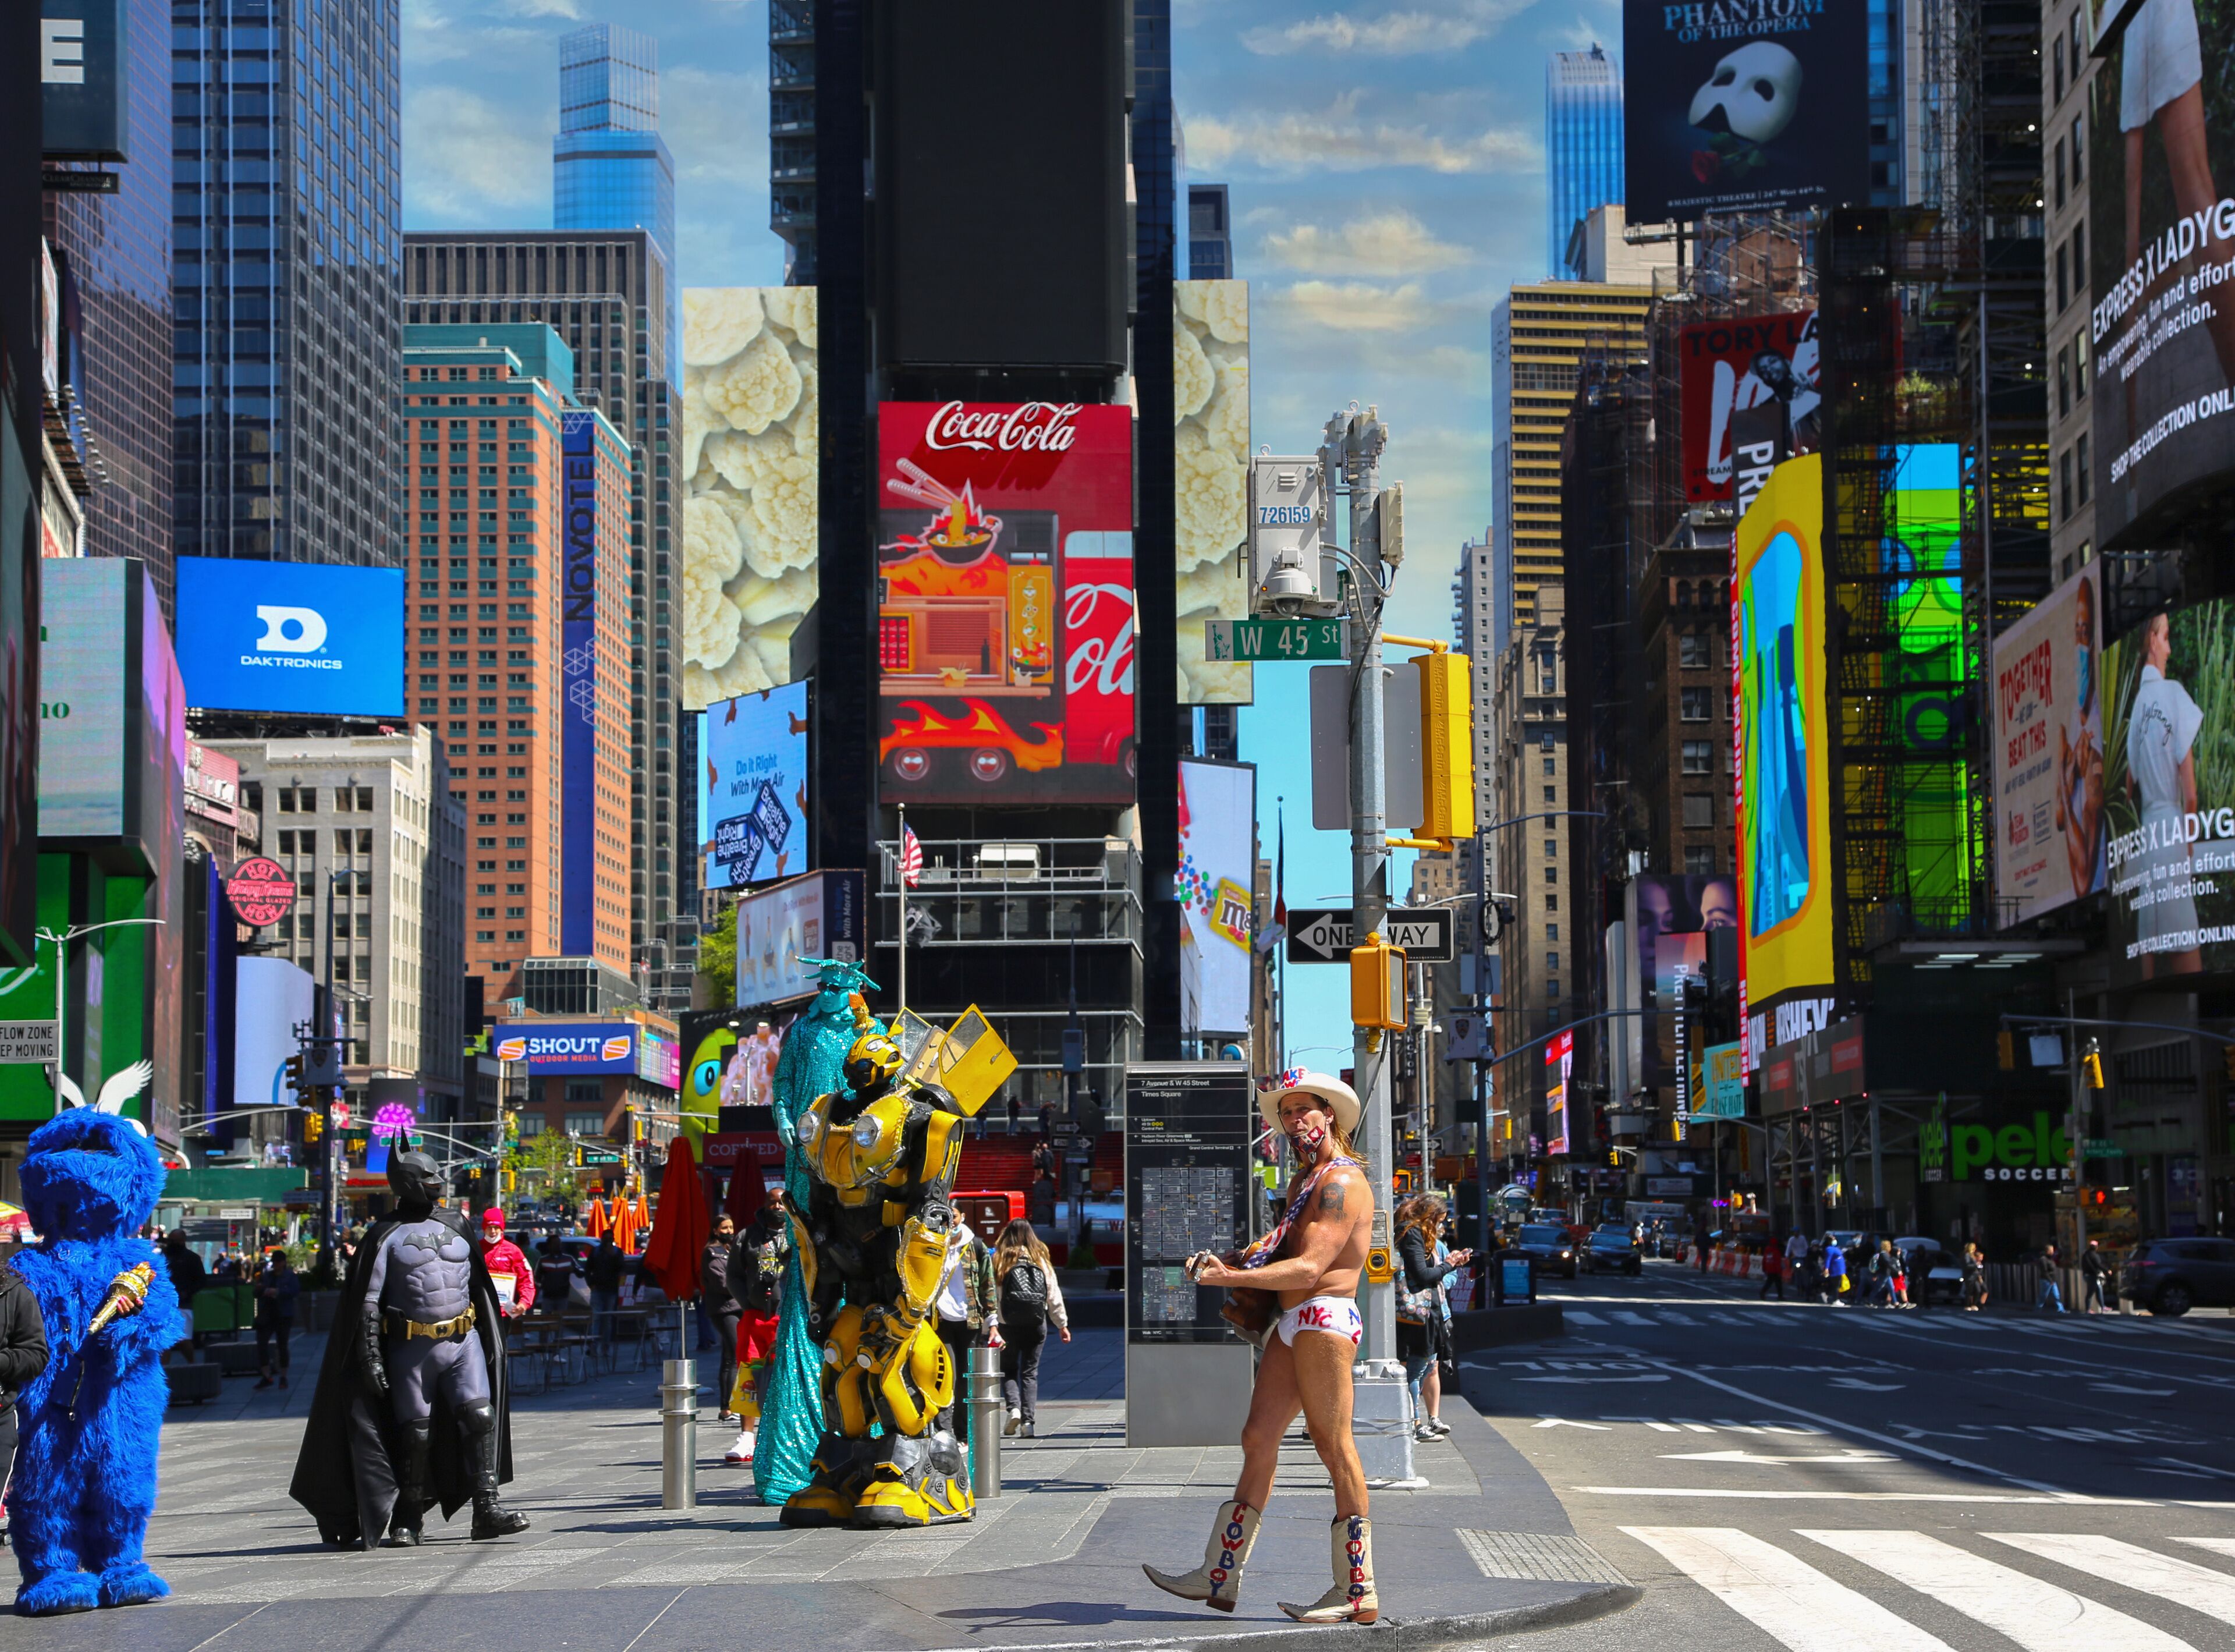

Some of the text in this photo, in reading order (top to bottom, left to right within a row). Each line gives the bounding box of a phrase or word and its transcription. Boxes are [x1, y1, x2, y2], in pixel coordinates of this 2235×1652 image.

[1663, 0, 1825, 30] PHANTOM
[1678, 16, 1811, 44] OF THE OPERA
[1674, 196, 1715, 206] MAJESTIC
[1717, 192, 1757, 203] THEATRE
[2093, 258, 2144, 344] EXPRESS
[2146, 243, 2155, 288] X
[2107, 313, 2149, 367] empowering,
[2149, 298, 2162, 324] fun
[2163, 275, 2185, 311] and
[1686, 323, 1777, 357] TORY
[2120, 300, 2217, 383] wearable collection.
[925, 399, 1084, 452] Coca-Cola
[2111, 451, 2129, 484] SHOP
[2128, 437, 2142, 467] THE
[2142, 400, 2196, 456] COLLECTION
[1260, 506, 1310, 524] 7-26159
[563, 435, 594, 622] NOVOTEL
[1240, 625, 1338, 655] W 45 St
[240, 655, 342, 670] DAKTRONICS
[2000, 638, 2053, 737] TOGETHER
[2009, 718, 2046, 768] BEAT THIS
[736, 760, 747, 776] Do
[755, 754, 778, 773] Right
[731, 771, 785, 797] With Air
[761, 785, 787, 833] Breathe
[717, 824, 737, 842] Right
[2108, 824, 2147, 870] EXPRESS
[2149, 821, 2158, 852] X
[717, 839, 748, 859] Breathe
[246, 863, 276, 877] HOT
[2152, 863, 2166, 881] fun
[2169, 856, 2190, 876] and
[2156, 877, 2219, 902] collection.
[244, 904, 278, 920] NOW
[843, 879, 851, 938] With More Air
[1312, 925, 1429, 946] ONE WAY
[2147, 930, 2197, 953] COLLECTION
[27, 1026, 53, 1039] ZONE
[16, 1044, 53, 1057] MOVING
[528, 1037, 600, 1055] SHOUT
[530, 1054, 597, 1063] OUTDOOR MEDIA
[1984, 1168, 2073, 1181] SOCCER
[1298, 1304, 1332, 1328] NYC
[1458, 1361, 1651, 1371] ONLY
[1530, 1413, 1831, 1435] ONLY
[1209, 1503, 1247, 1597] COWBOY
[1345, 1515, 1365, 1612] COWBOY
